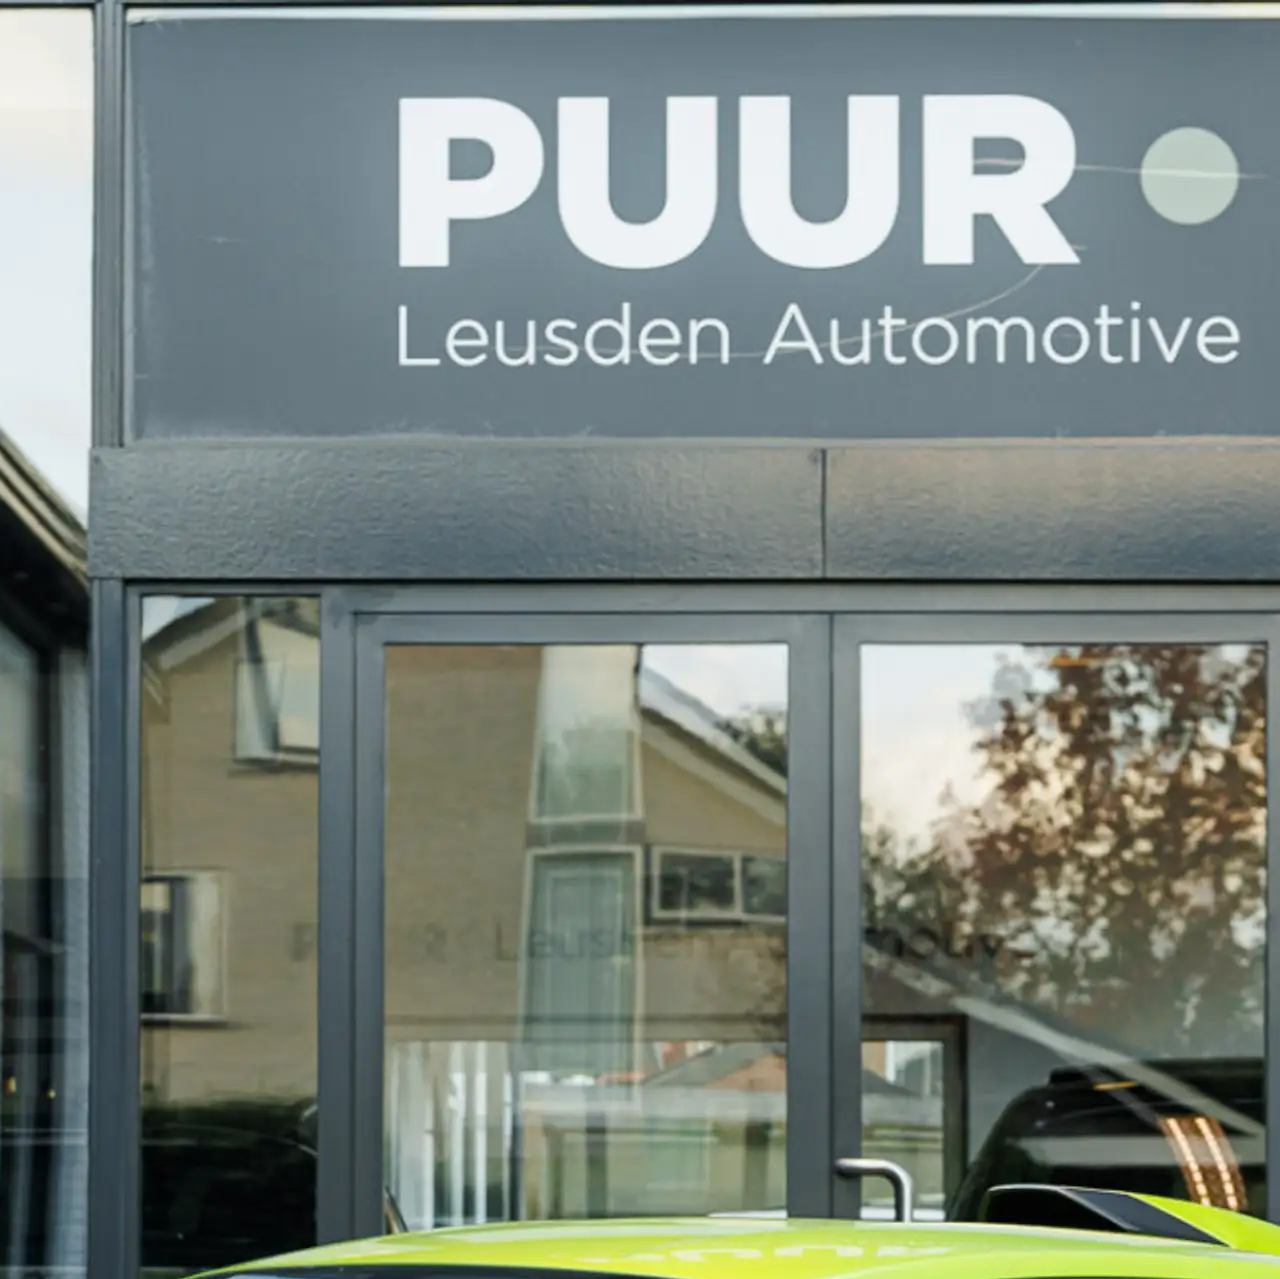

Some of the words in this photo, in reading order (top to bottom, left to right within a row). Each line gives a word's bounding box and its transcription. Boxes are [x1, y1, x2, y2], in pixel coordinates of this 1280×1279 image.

[399, 95, 1080, 269] PUUR
[399, 302, 730, 366] Leusden
[763, 301, 1240, 366] Automotive
